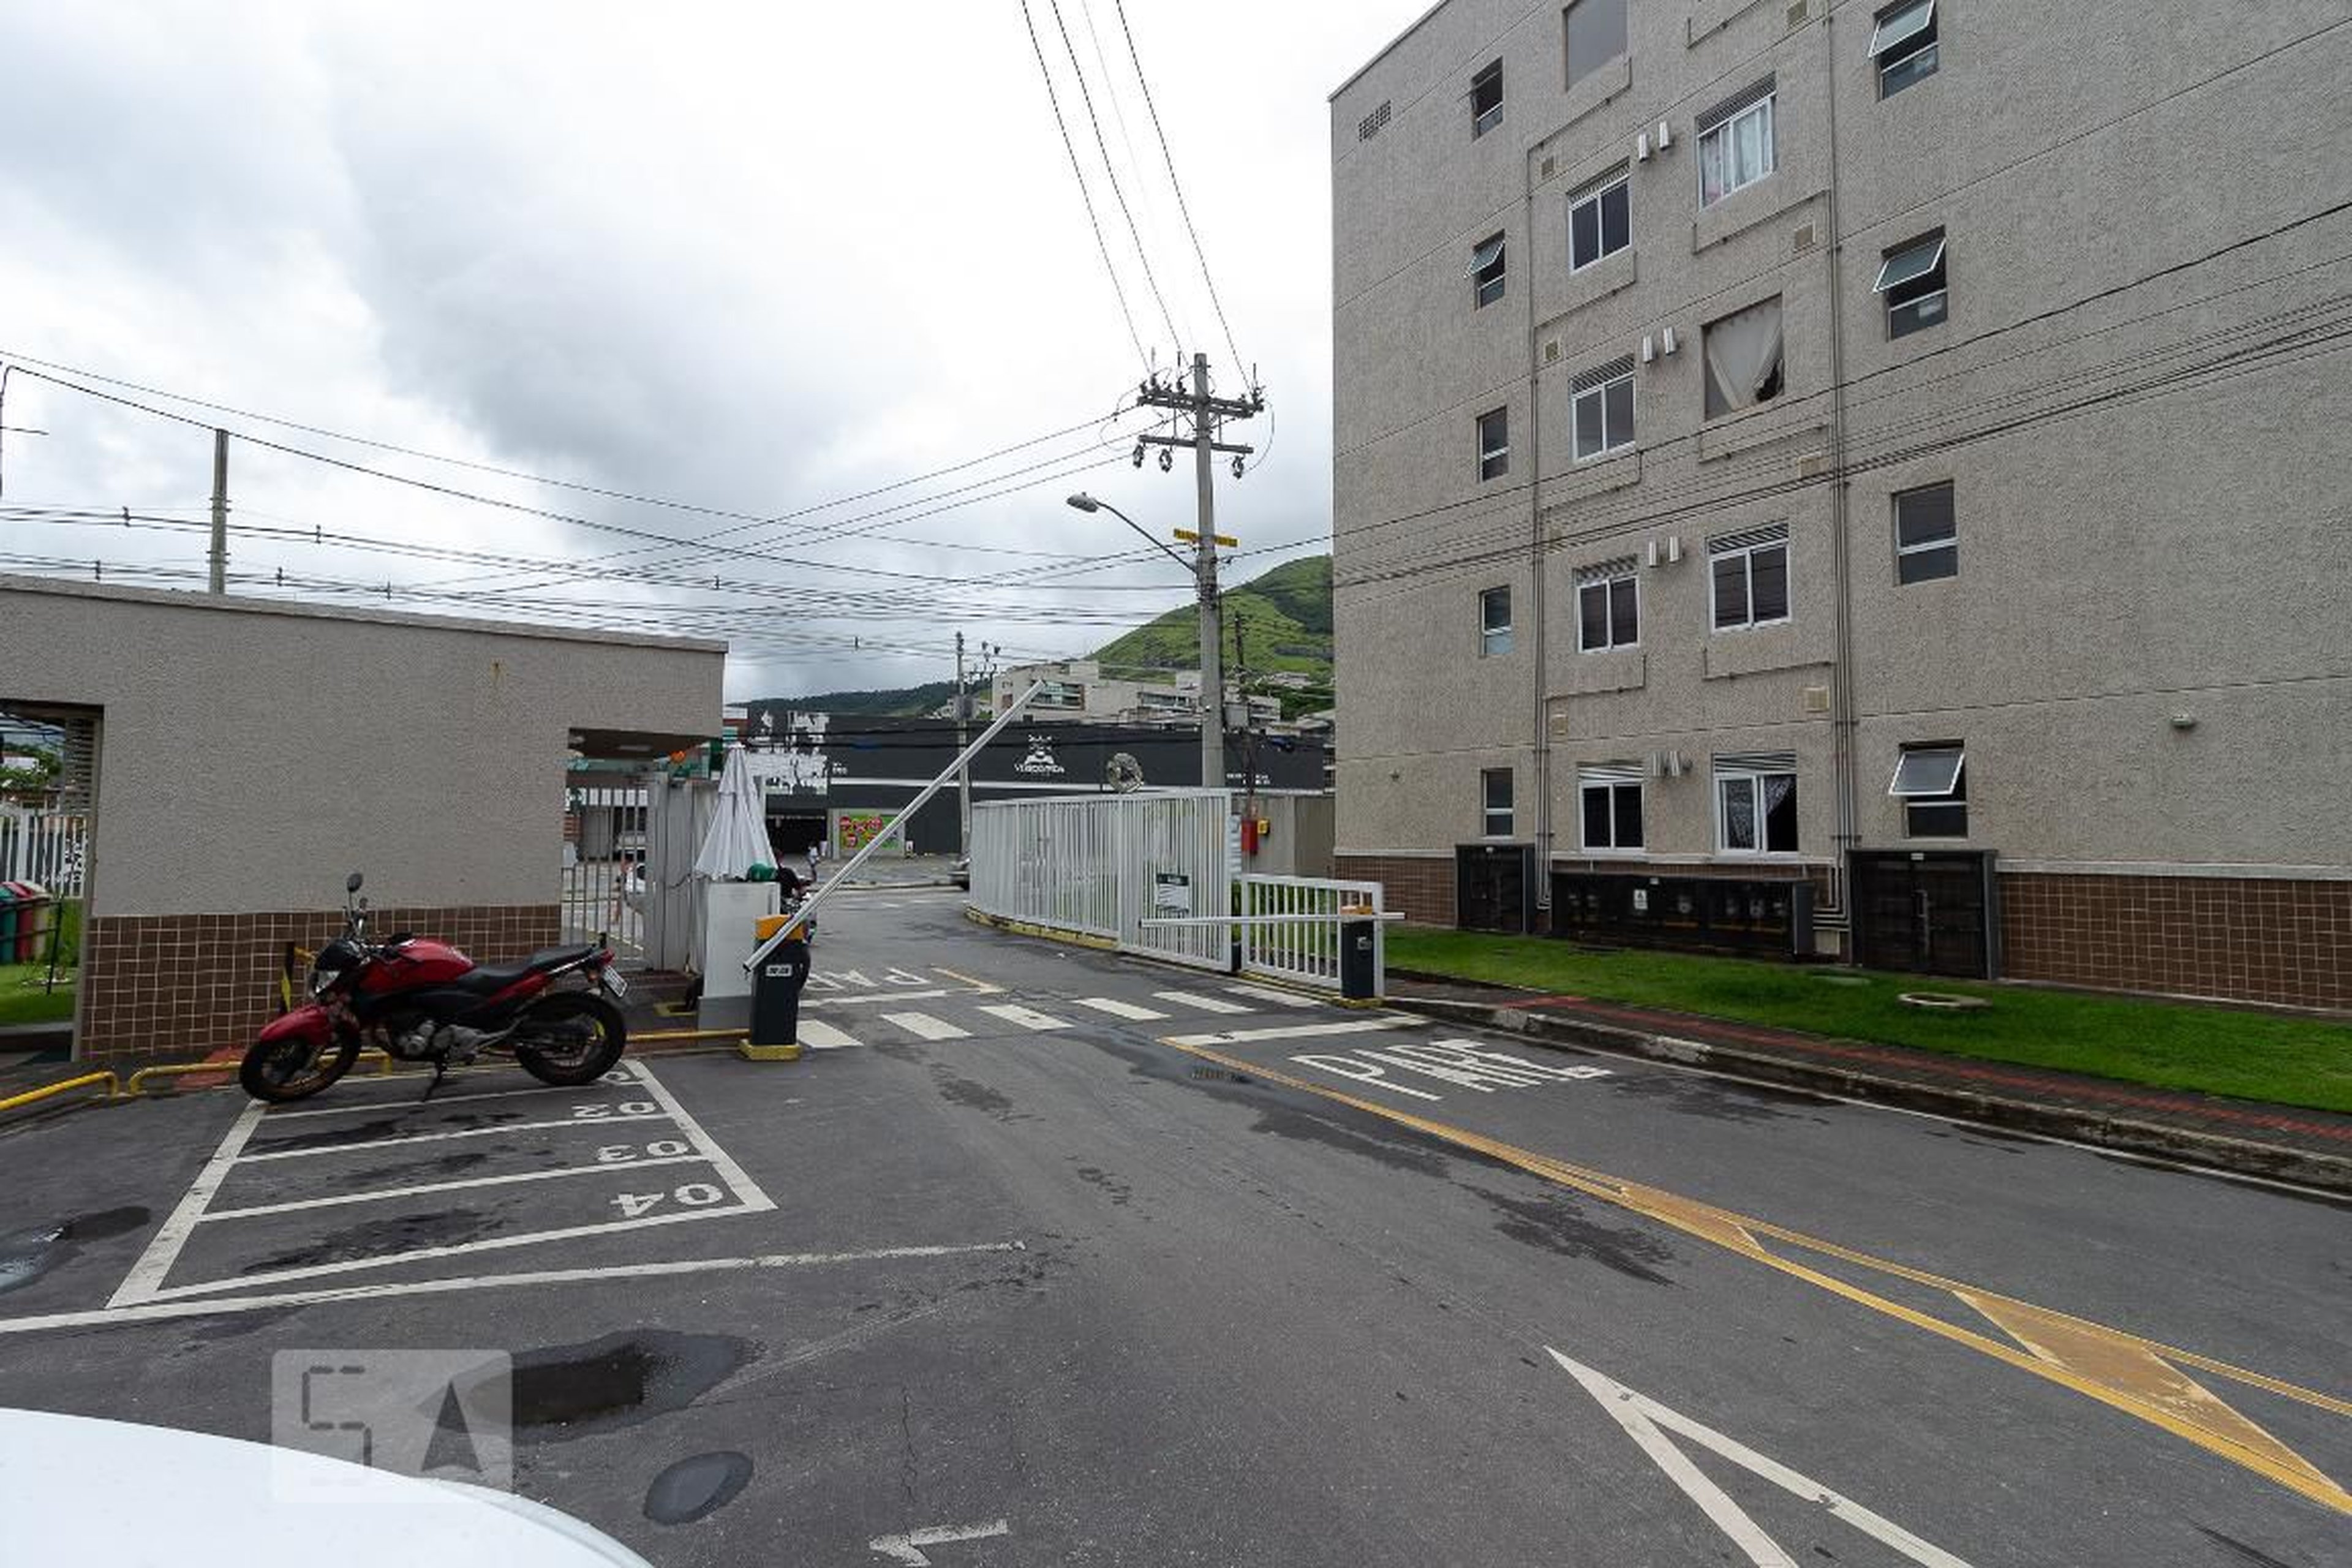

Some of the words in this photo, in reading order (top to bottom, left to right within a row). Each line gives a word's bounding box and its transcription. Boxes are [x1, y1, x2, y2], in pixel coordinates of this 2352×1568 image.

[1289, 1039, 1615, 1101] PARE
[571, 1102, 656, 1117] 02
[598, 1141, 689, 1162] 03
[610, 1183, 723, 1217] 04
